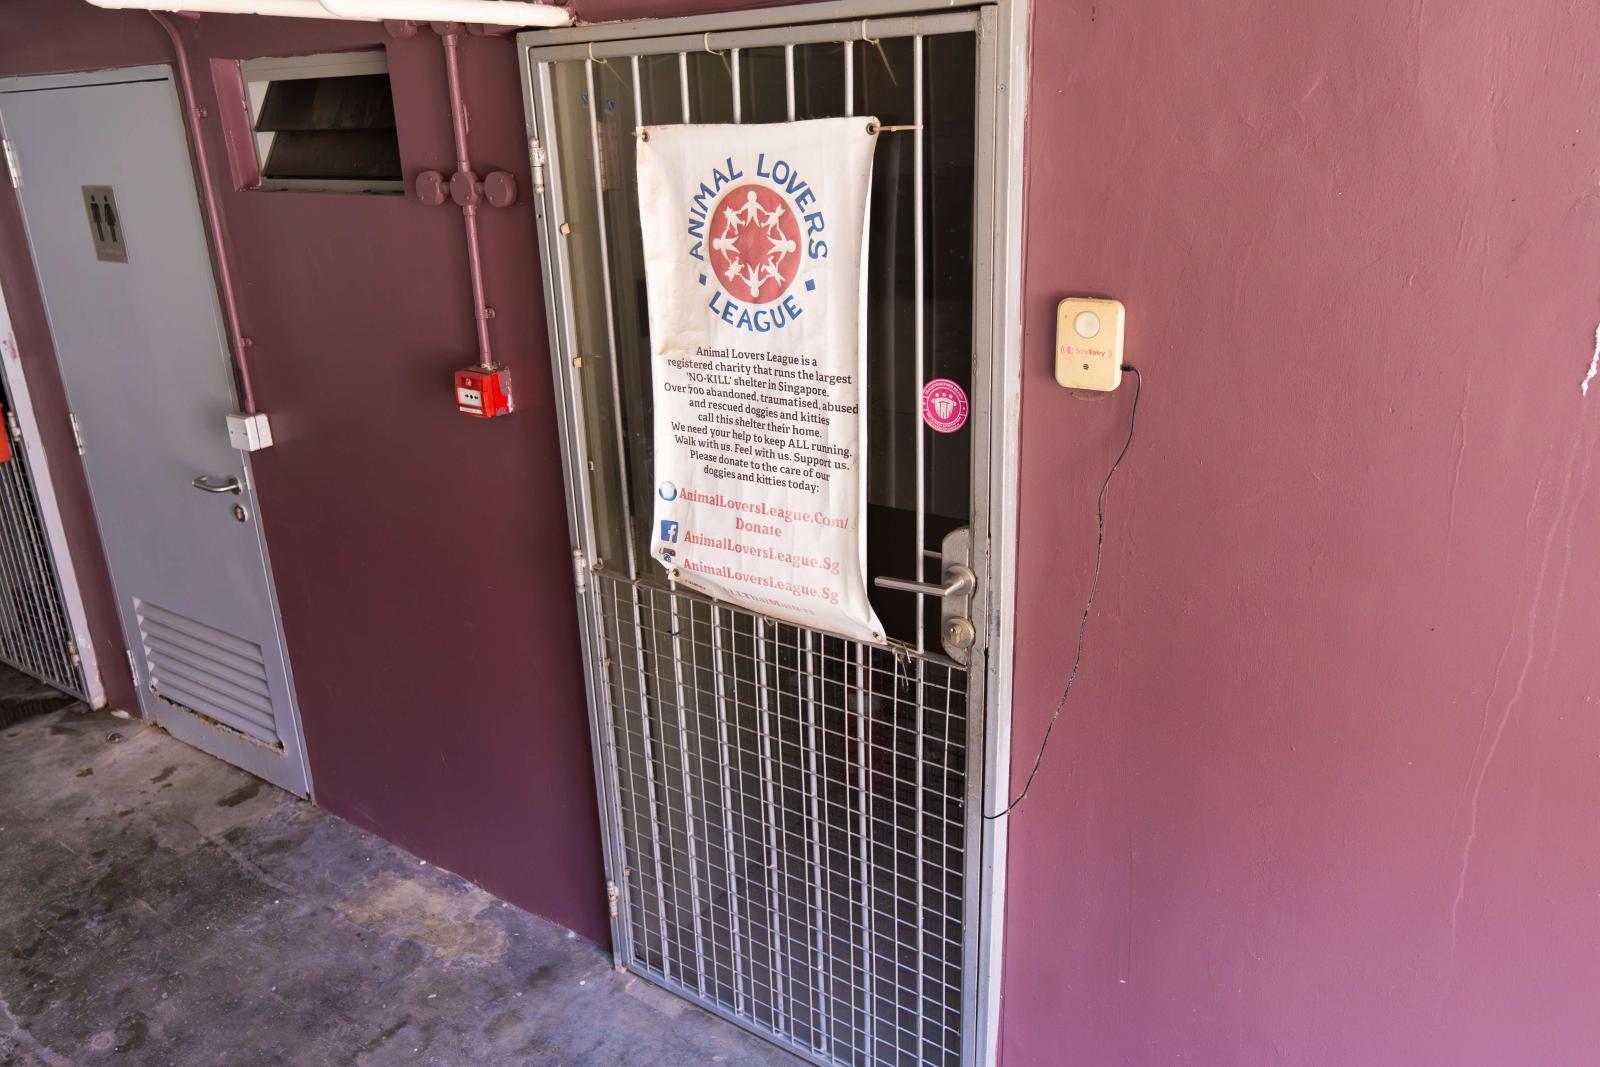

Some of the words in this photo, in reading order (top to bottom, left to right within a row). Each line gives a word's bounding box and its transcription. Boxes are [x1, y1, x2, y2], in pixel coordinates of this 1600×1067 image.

[688, 156, 743, 261] ANIMAL
[757, 154, 828, 260] LOVERS
[708, 290, 804, 332] LEAGUE
[668, 358, 713, 370] registered
[715, 362, 751, 375] charity
[754, 364, 772, 376] that
[774, 369, 796, 378] runs
[798, 370, 814, 380] the
[816, 370, 852, 385] largest
[696, 346, 729, 358] Animal
[732, 349, 764, 360] Lovers
[767, 352, 799, 366] League
[802, 355, 810, 366] is
[812, 358, 817, 366] a
[664, 382, 686, 392] Over
[688, 386, 704, 395] 700
[822, 402, 858, 414] abused
[734, 376, 766, 388] shelter
[768, 379, 776, 390] in
[778, 382, 829, 397] Singapore.
[689, 399, 705, 408] and
[708, 402, 744, 412] rescued
[745, 404, 778, 418] doggies
[780, 411, 798, 421] and
[801, 412, 830, 426] kitties
[698, 413, 714, 422] call
[716, 414, 733, 424] this
[735, 416, 765, 429] shelter
[767, 422, 790, 434] their
[792, 425, 822, 438] home.
[671, 422, 685, 431] We
[687, 426, 708, 435] need
[710, 428, 730, 438] your
[732, 429, 751, 443] help
[754, 434, 762, 443] to
[765, 434, 785, 449] keep
[788, 438, 810, 450] ALL
[812, 443, 852, 459] running.
[674, 434, 696, 446] Walk
[698, 439, 719, 449] with
[721, 444, 732, 452] us.
[735, 444, 752, 455] Feel
[755, 448, 775, 459] with
[778, 452, 792, 461] us.
[794, 452, 831, 468] Support
[835, 461, 850, 470] us.
[690, 450, 717, 462] Please
[719, 454, 748, 468] donate
[750, 461, 760, 470] to
[762, 462, 777, 472] the
[780, 466, 800, 475] care
[803, 468, 814, 477] of
[816, 472, 830, 481] our
[704, 465, 735, 479] doggies
[737, 473, 754, 482] and
[757, 474, 786, 486] kitties
[788, 480, 819, 493] today:
[735, 517, 783, 536] Donate
[684, 530, 840, 575] AnimalLoversLeague.Sg
[684, 559, 839, 605] AnimalLoversLeague.Sg
